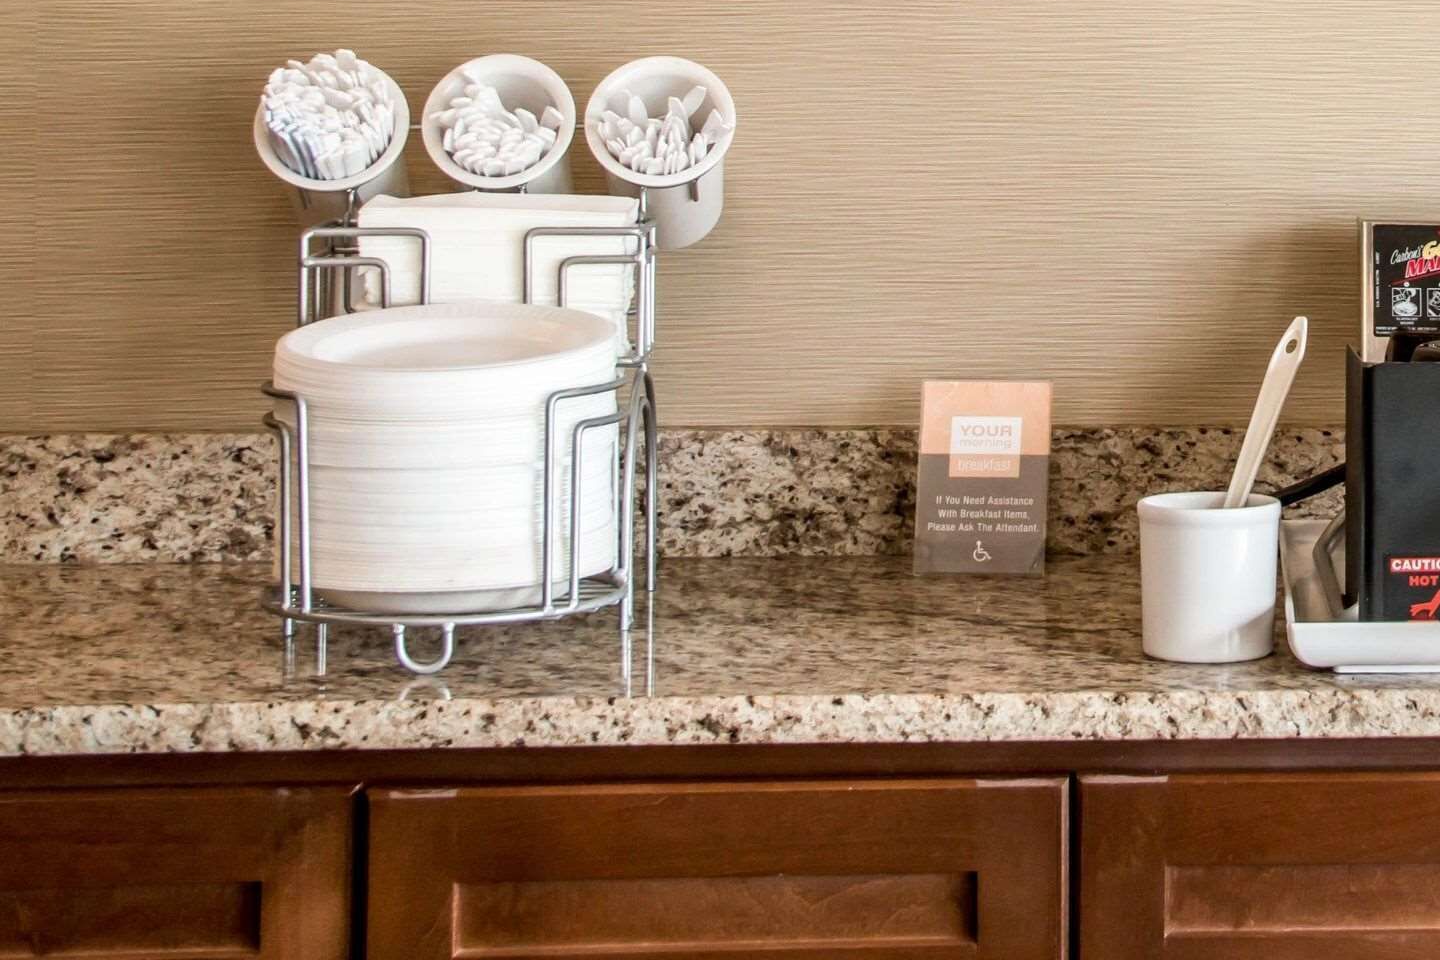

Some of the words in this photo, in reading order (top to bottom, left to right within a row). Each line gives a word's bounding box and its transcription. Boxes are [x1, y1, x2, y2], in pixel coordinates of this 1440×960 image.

[960, 425, 1013, 437] YOUR
[959, 438, 1012, 449] morning
[936, 496, 942, 505] If
[945, 496, 960, 505] You
[963, 496, 985, 505] Need
[987, 496, 1034, 506] Assistance
[938, 509, 957, 518] With
[960, 509, 1001, 518] Breakfast
[927, 522, 955, 531] Please
[958, 522, 974, 531] Ask
[977, 523, 993, 532] The
[995, 523, 1040, 532] Attendant.
[1409, 575, 1439, 586] HOT
